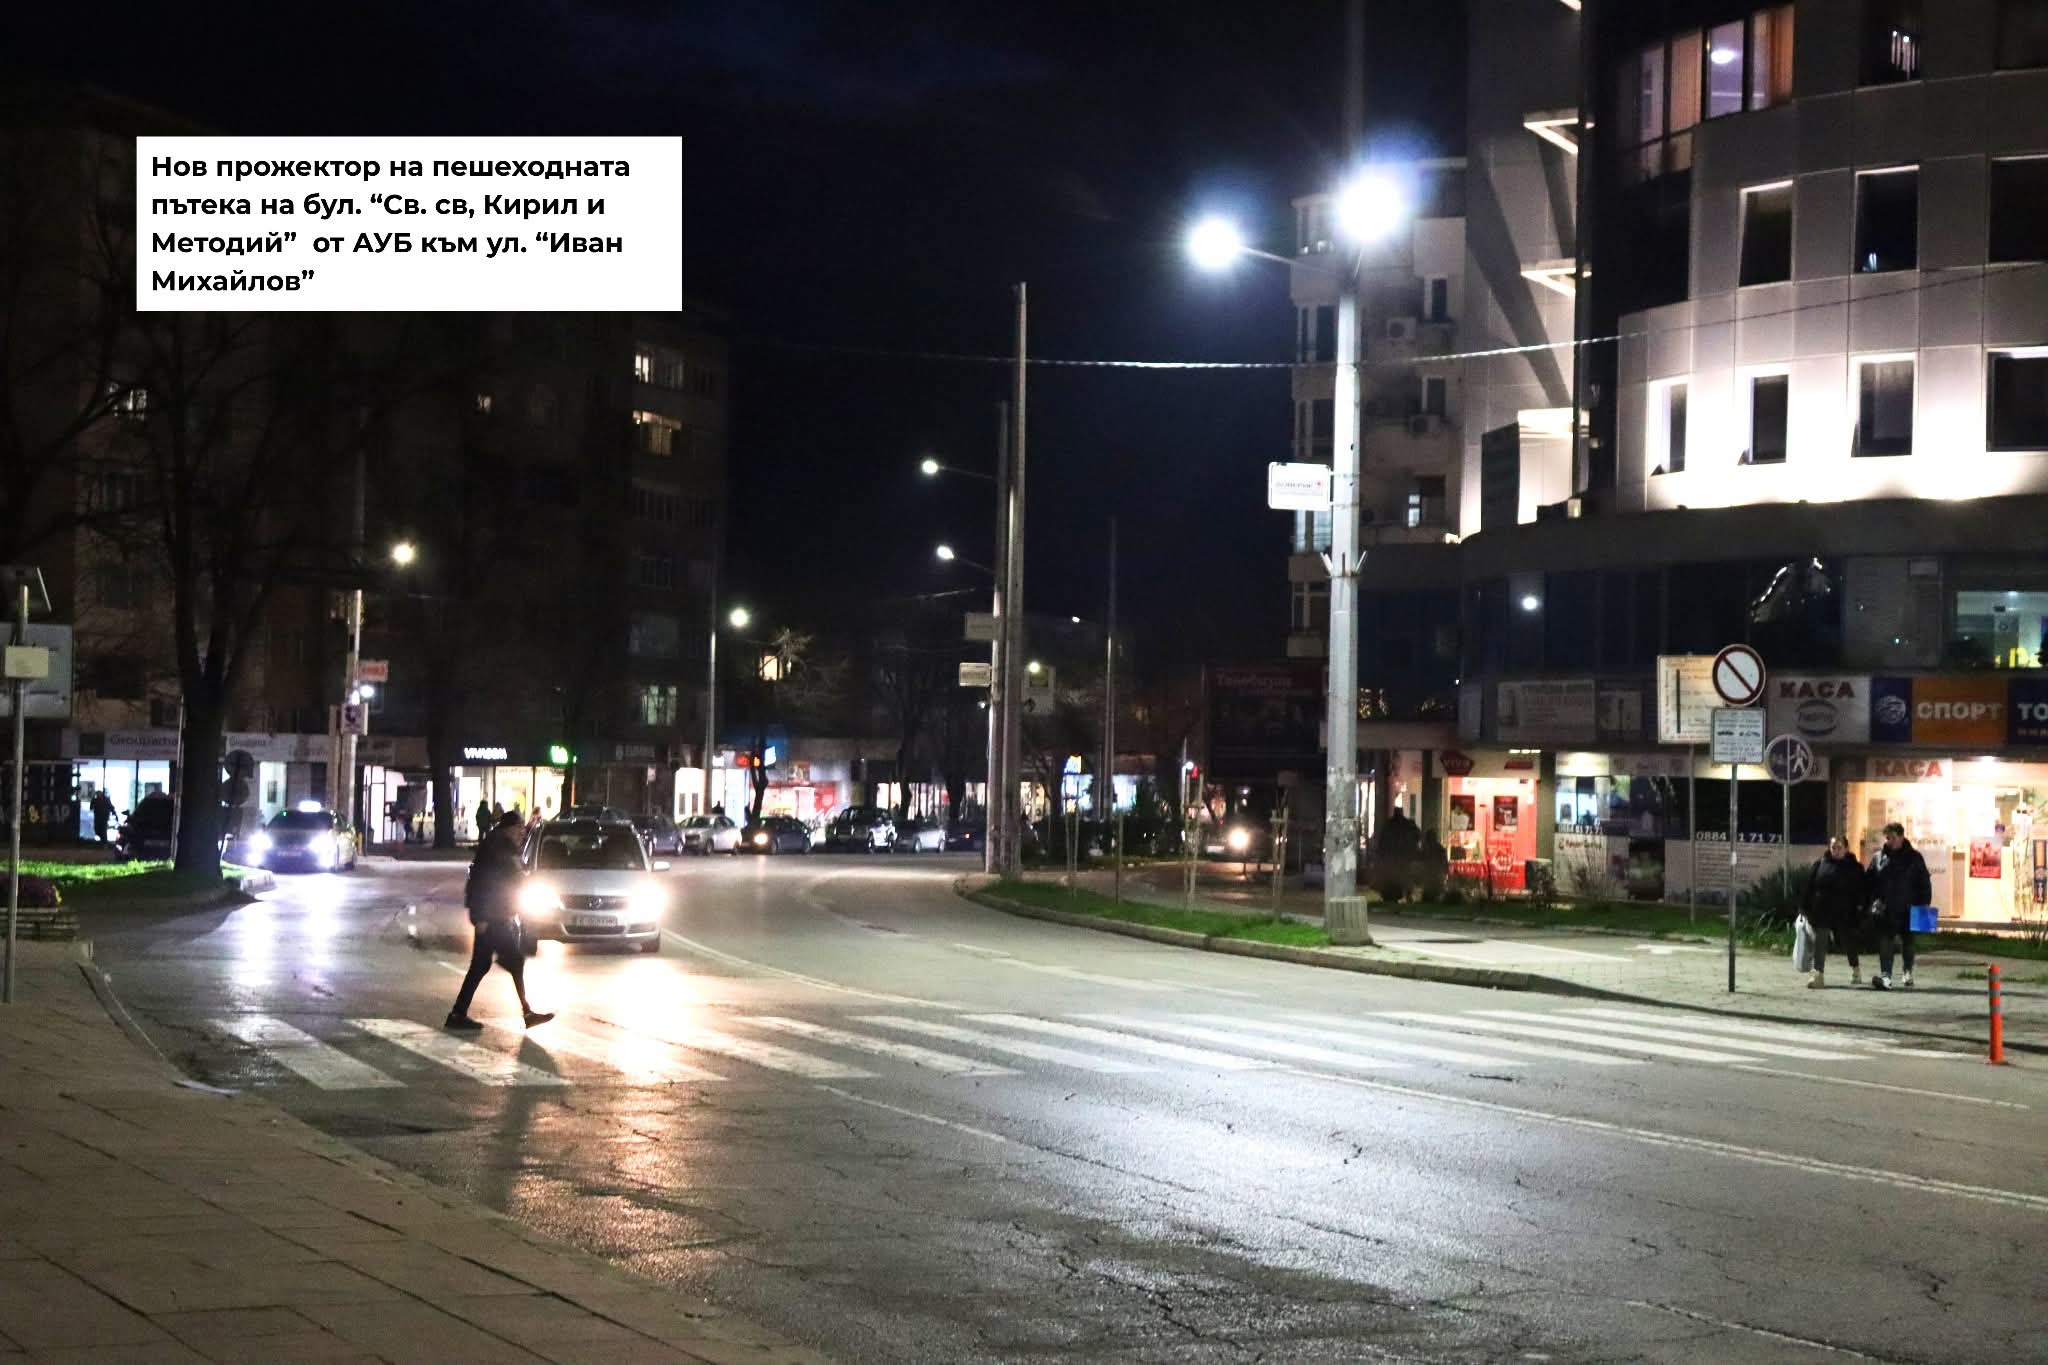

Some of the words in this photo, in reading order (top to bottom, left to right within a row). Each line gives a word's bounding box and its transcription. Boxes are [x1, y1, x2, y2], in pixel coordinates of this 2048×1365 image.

[1780, 681, 1855, 698] КАСА
[1917, 702, 2002, 720] СПОРТ
[1875, 760, 1943, 777] КАСА
[1696, 831, 1727, 841] 0884
